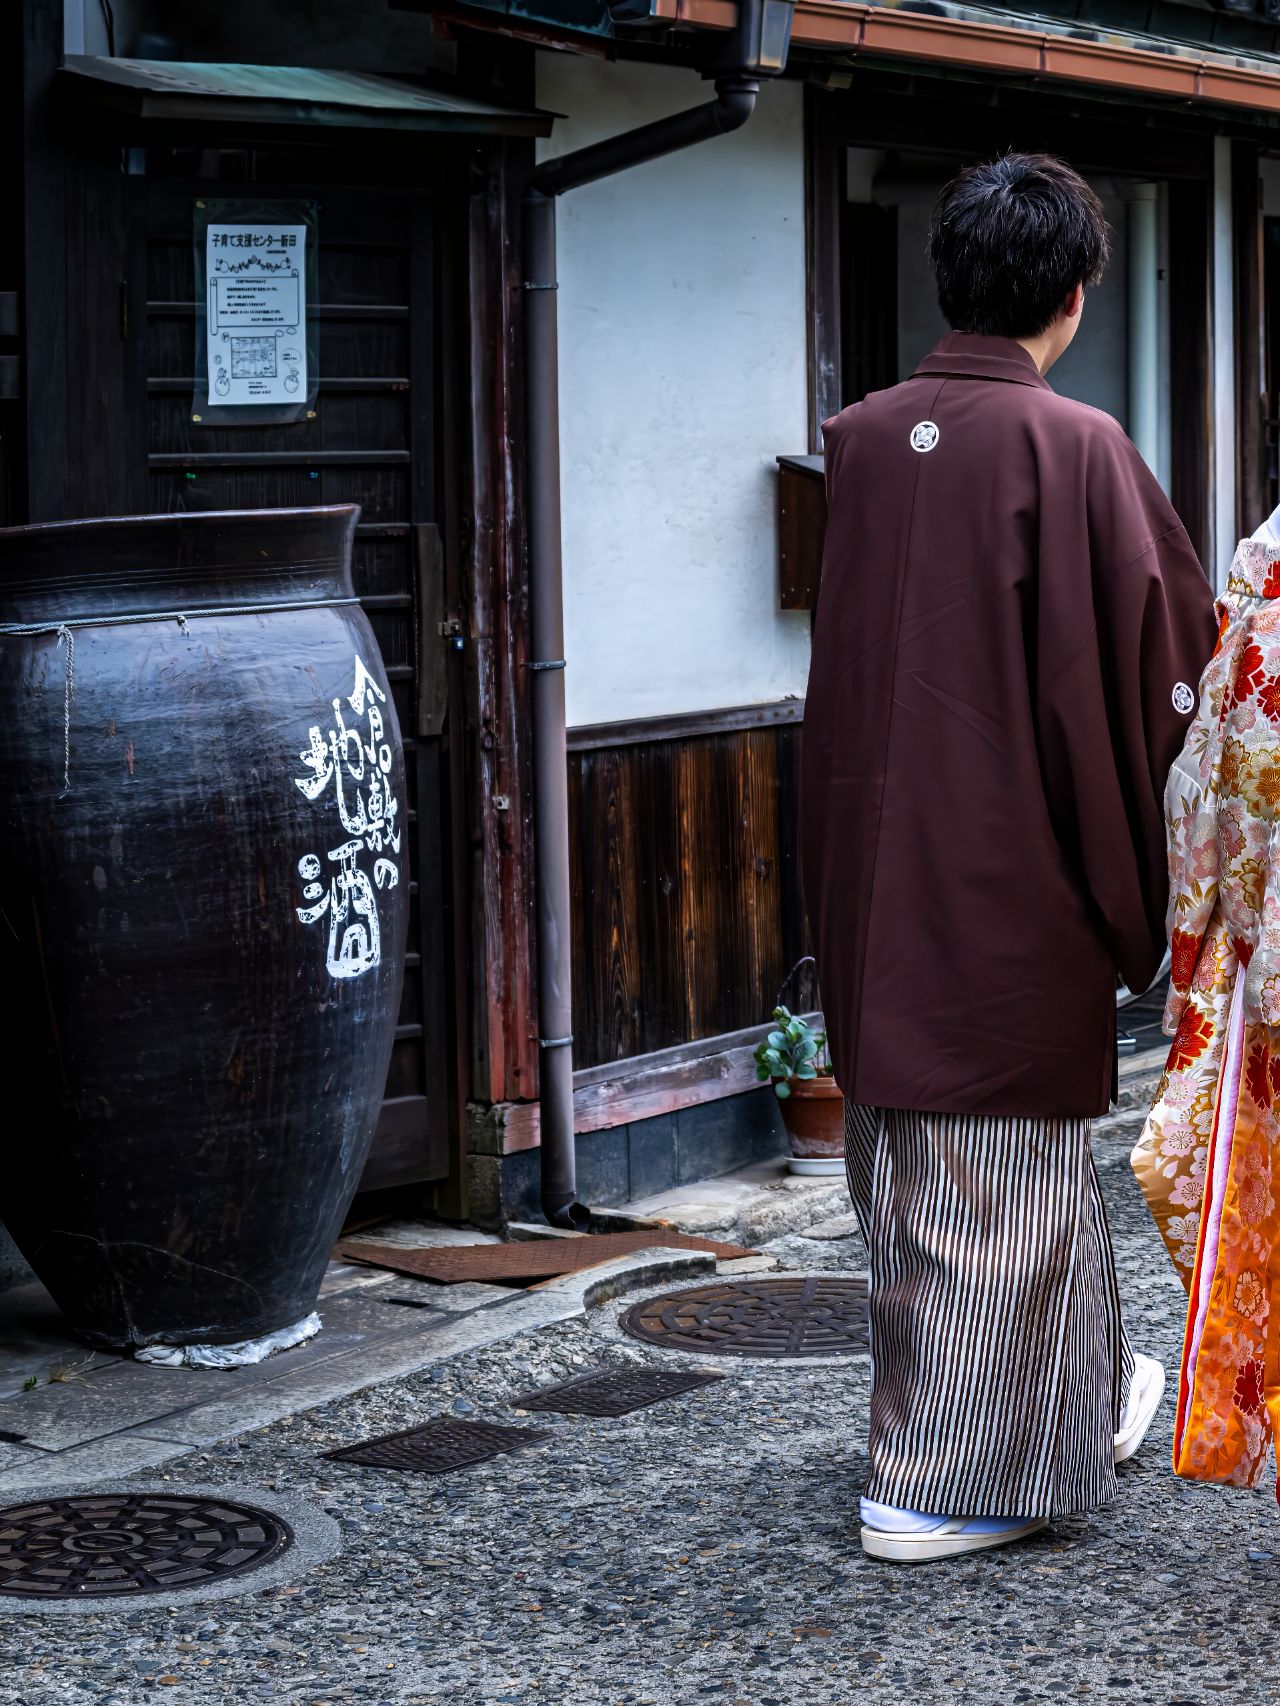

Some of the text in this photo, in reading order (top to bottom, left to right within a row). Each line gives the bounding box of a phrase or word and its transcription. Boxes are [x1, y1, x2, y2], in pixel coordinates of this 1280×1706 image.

[212, 233, 297, 248] 子育て支援センター新田
[295, 698, 380, 978] 地酒
[347, 654, 400, 890] 倉敷の
